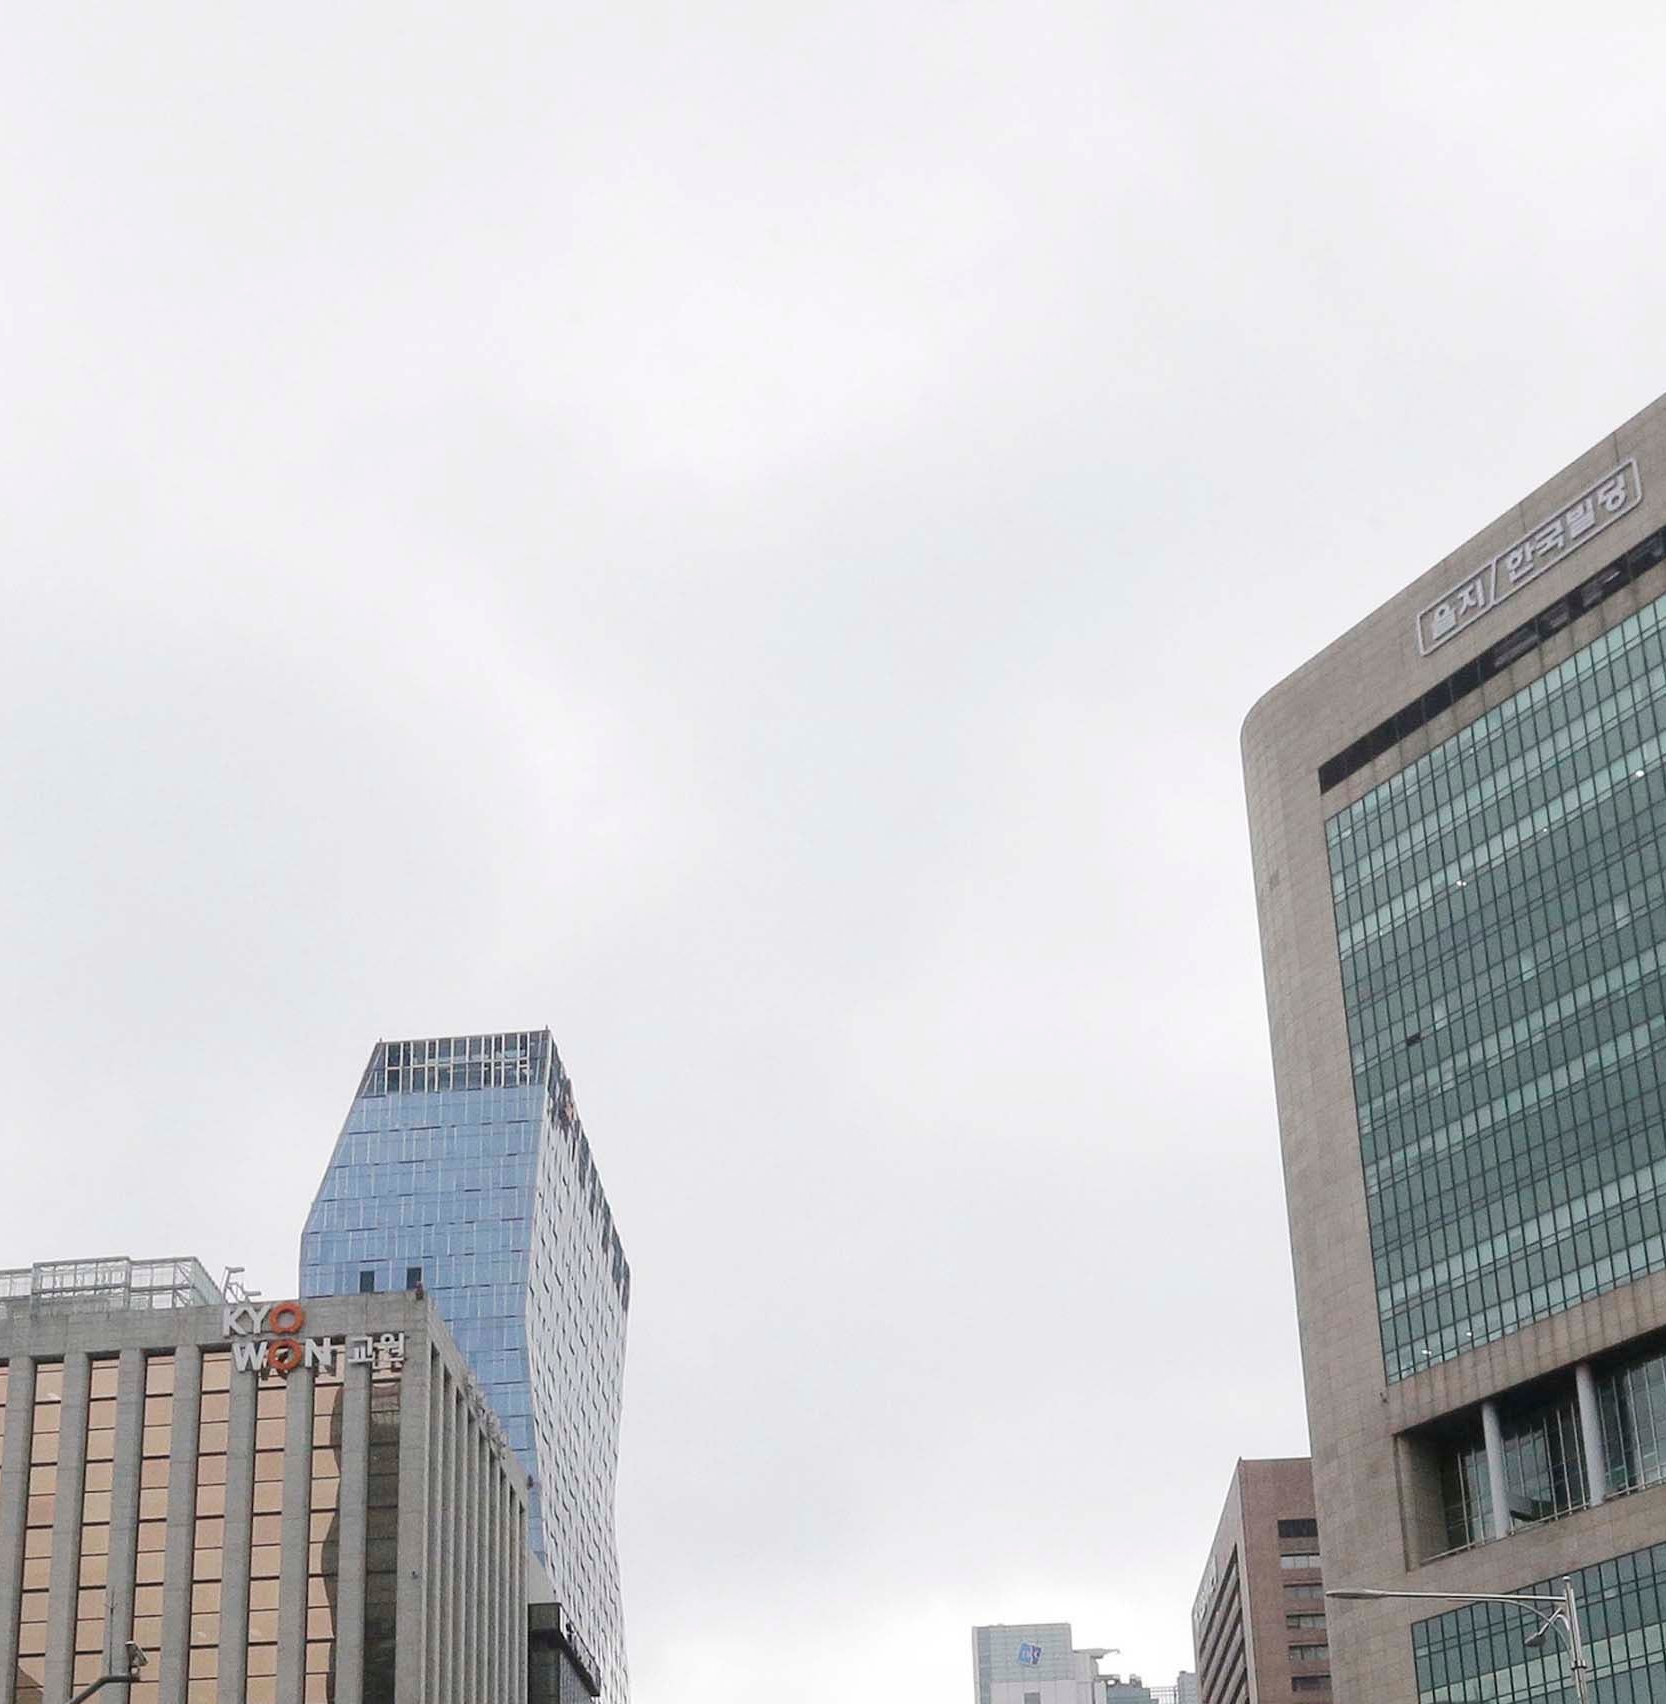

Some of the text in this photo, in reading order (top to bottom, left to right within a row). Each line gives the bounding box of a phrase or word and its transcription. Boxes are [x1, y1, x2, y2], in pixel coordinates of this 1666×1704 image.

[1433, 473, 1628, 642] 을지 한국빌딩
[222, 1302, 306, 1337] KYO
[232, 1337, 333, 1372] WON
[347, 1332, 406, 1364] 교원
